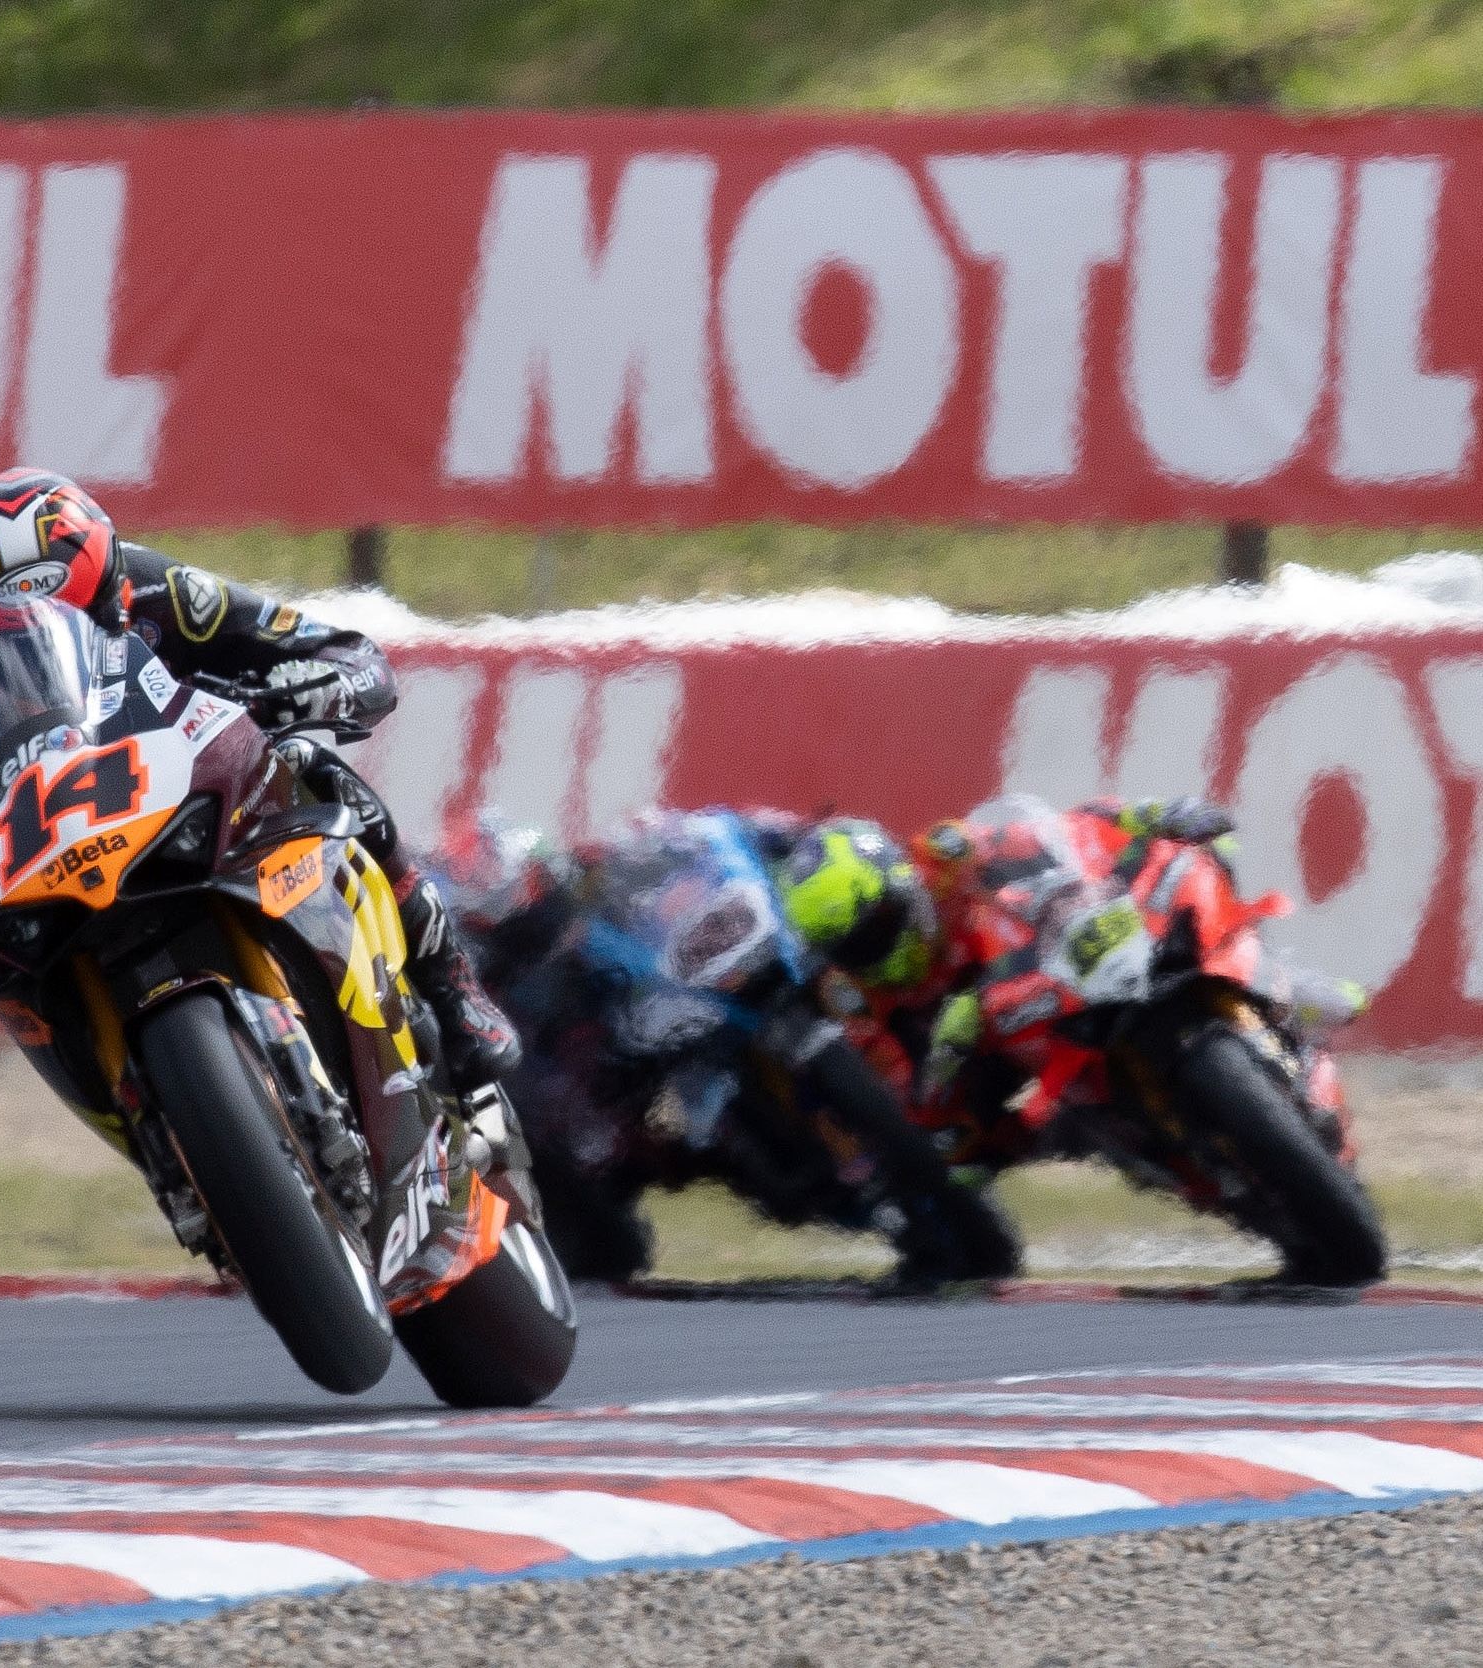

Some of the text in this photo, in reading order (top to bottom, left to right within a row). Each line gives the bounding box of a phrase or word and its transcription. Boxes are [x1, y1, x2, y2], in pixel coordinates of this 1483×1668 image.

[437, 145, 1477, 491] MOTUL
[2, 733, 47, 786] elf
[60, 832, 129, 874] Beta
